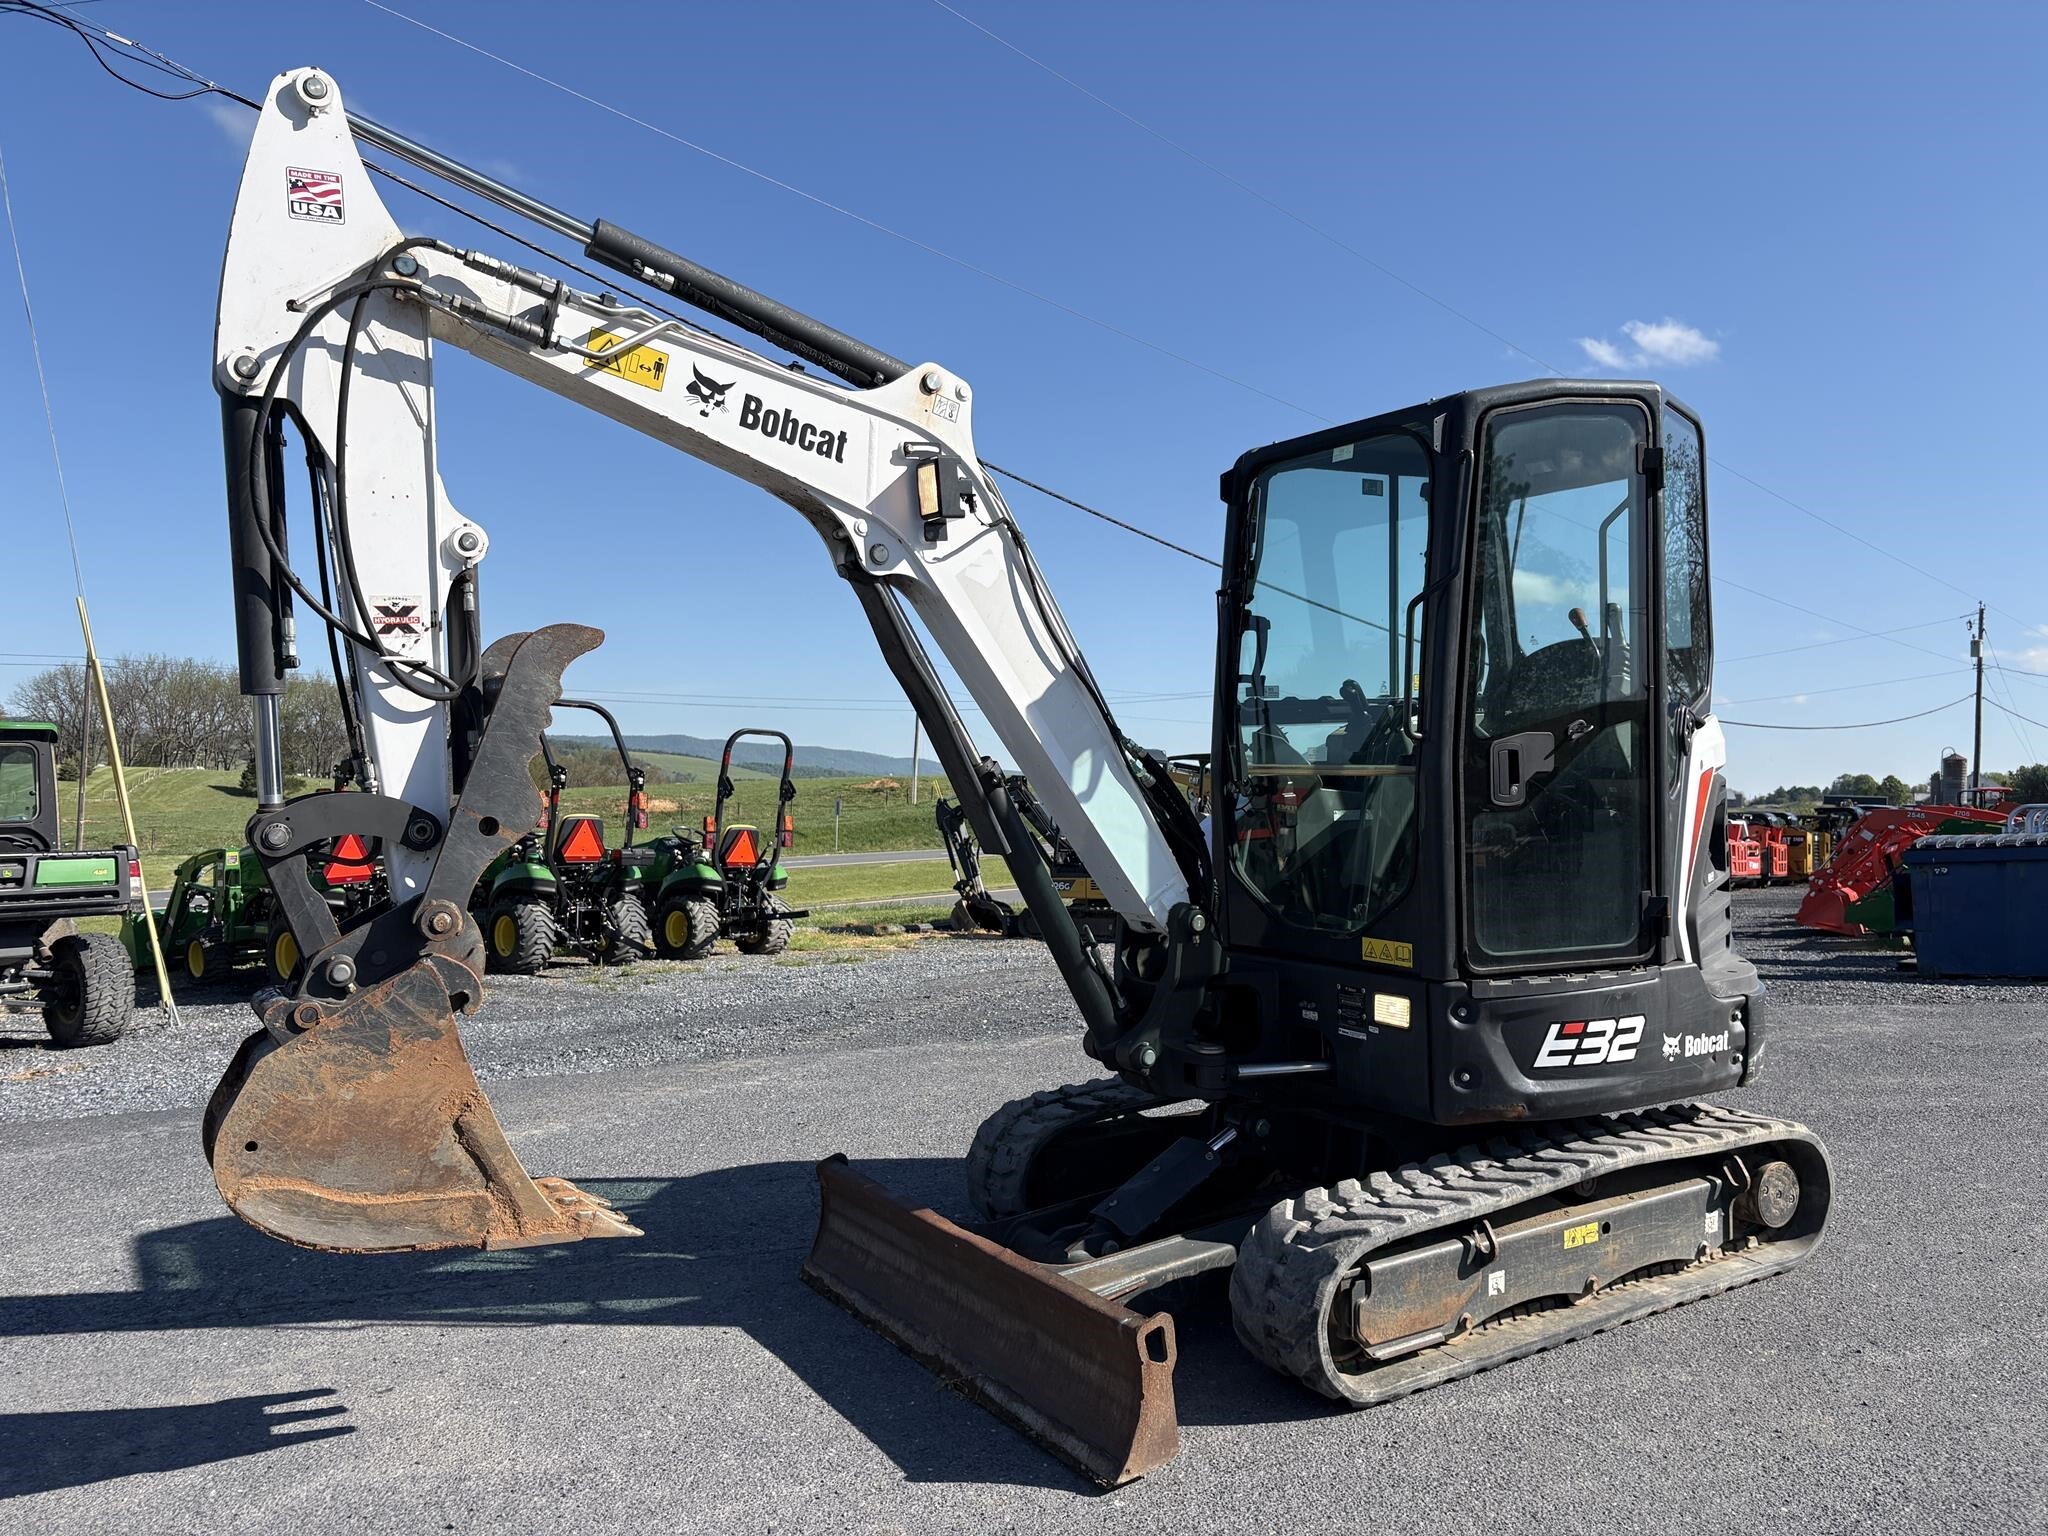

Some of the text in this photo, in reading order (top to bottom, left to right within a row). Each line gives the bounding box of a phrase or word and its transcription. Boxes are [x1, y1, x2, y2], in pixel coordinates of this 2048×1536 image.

[290, 170, 312, 179] MADE
[293, 202, 340, 218] USA
[739, 393, 848, 464] Bobcat
[1533, 1014, 1646, 1068] E32
[1684, 1030, 1731, 1058] Bobcat
